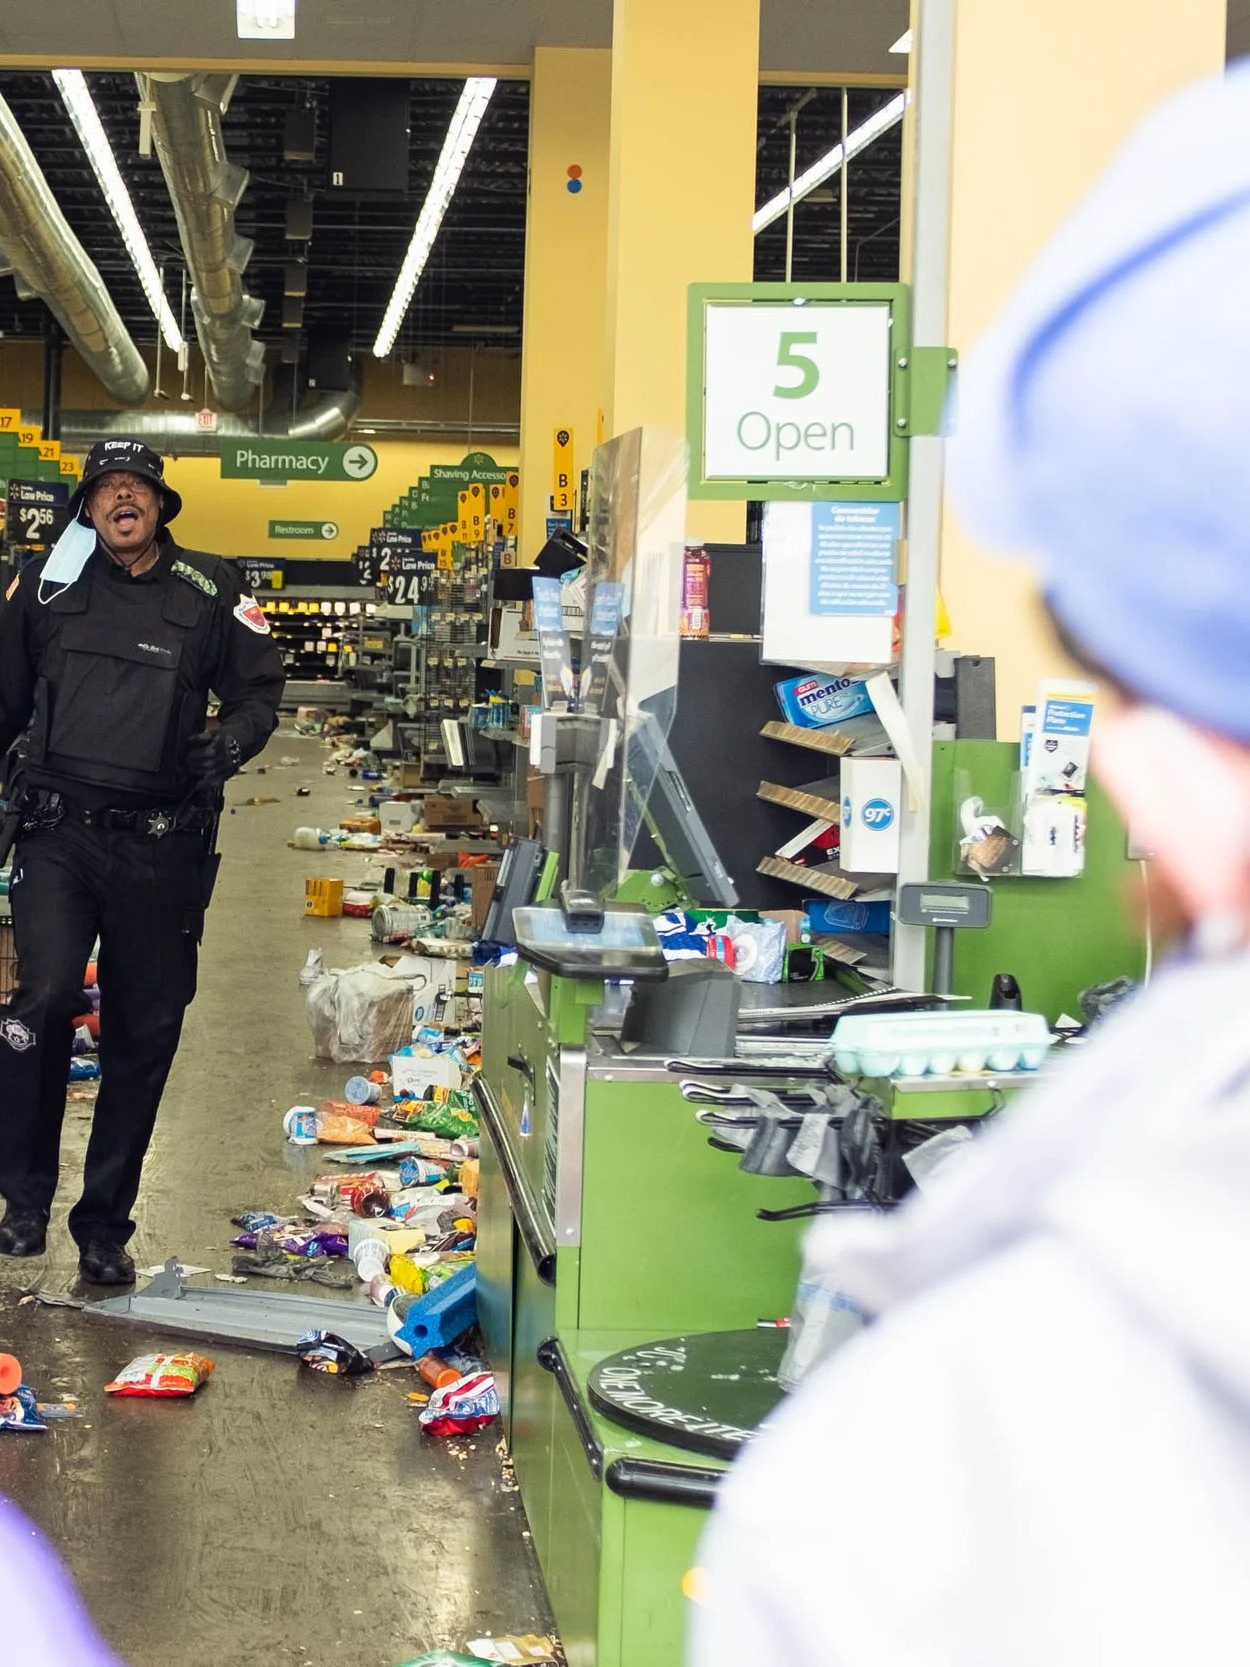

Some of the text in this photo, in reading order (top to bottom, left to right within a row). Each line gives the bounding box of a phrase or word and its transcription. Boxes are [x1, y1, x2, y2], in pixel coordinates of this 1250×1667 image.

[772, 331, 820, 399] 5
[19, 433, 33, 443] 19
[736, 411, 855, 461] Open
[40, 448, 54, 457] 21
[104, 441, 144, 453] KEEP IT
[236, 450, 329, 474] Pharmacy
[434, 469, 507, 481] Shaving Accesso
[558, 474, 568, 487] B
[21, 488, 35, 500] Low
[36, 491, 54, 502] Price
[560, 495, 567, 506] 3
[508, 508, 516, 519] B
[473, 516, 479, 526] B
[274, 525, 315, 534] Restroom
[811, 694, 842, 717] PURE
[600, 1366, 642, 1390] ONE
[605, 1388, 705, 1425] MORE
[684, 1422, 764, 1442] ITE
